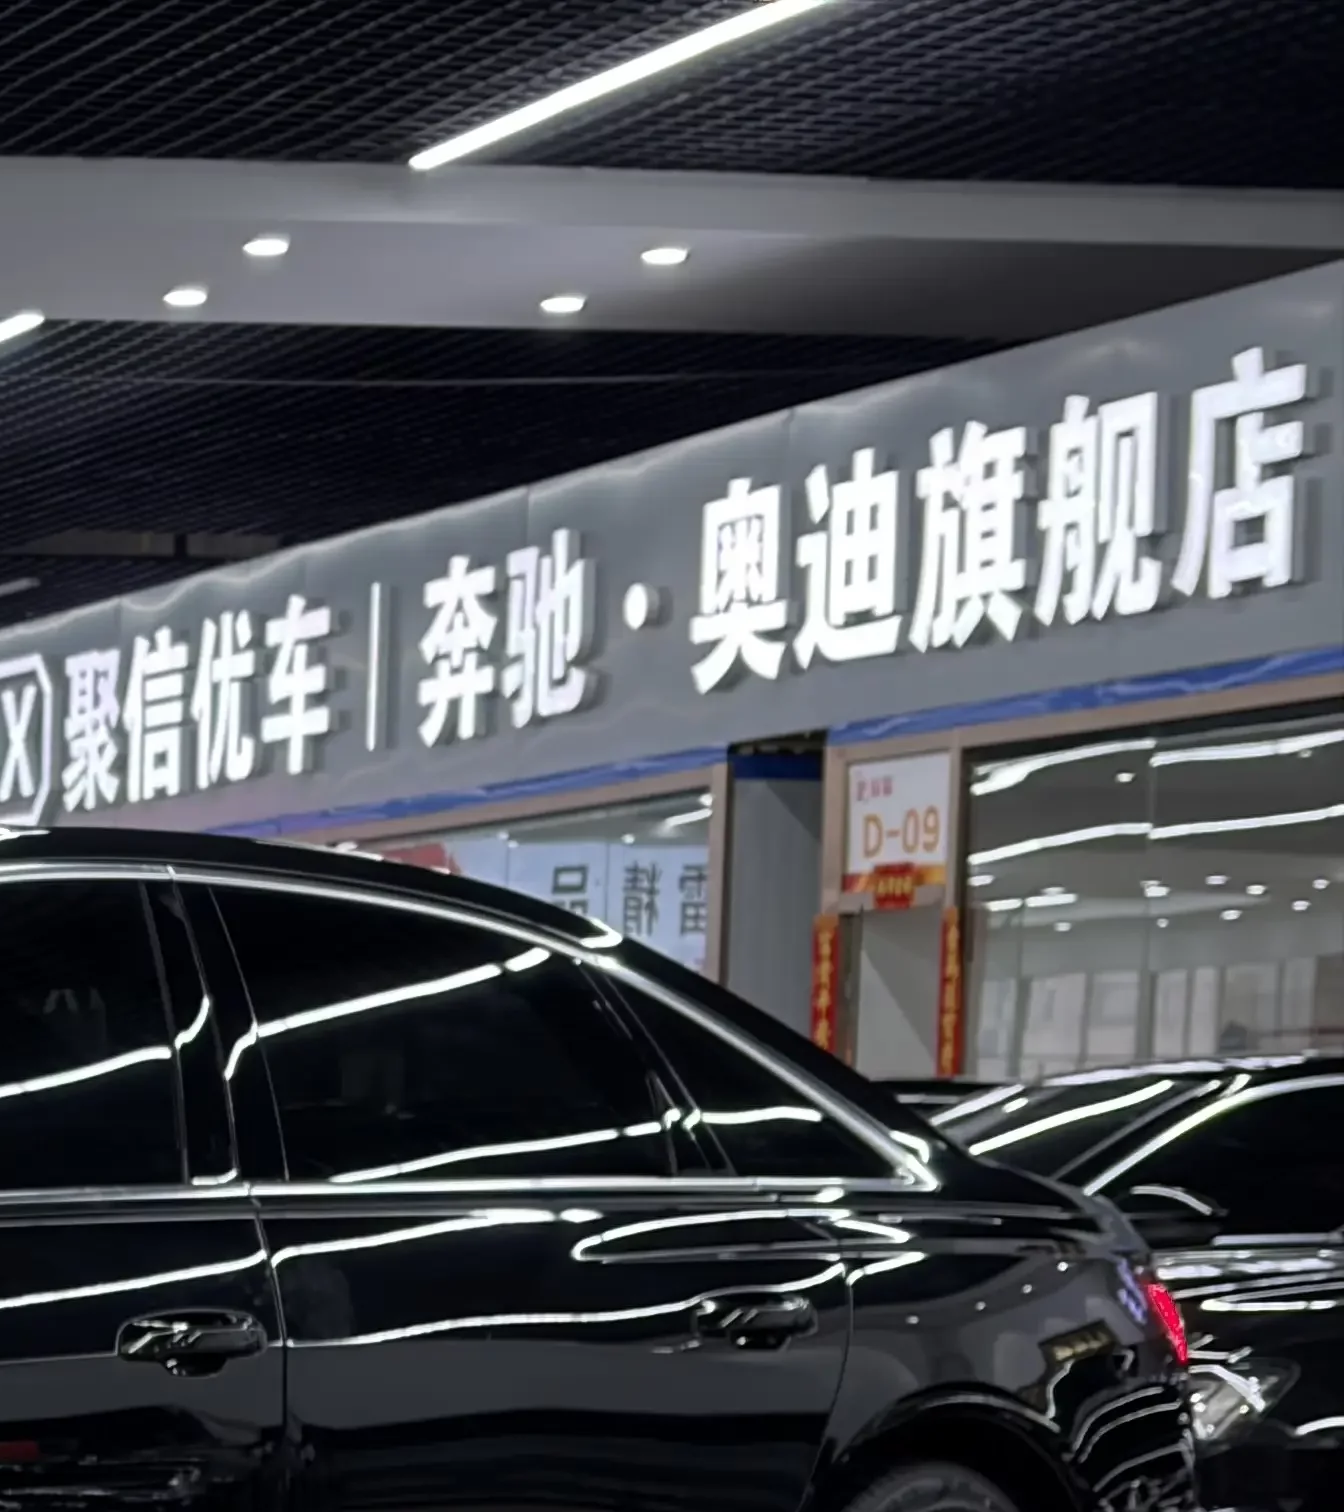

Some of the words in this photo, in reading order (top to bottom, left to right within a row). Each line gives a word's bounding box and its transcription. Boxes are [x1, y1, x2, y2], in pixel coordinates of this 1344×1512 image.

[62, 594, 330, 812] 聚信优车
[418, 346, 1309, 748] 奔驰·奥迪旗舰店
[863, 804, 941, 859] D-09
